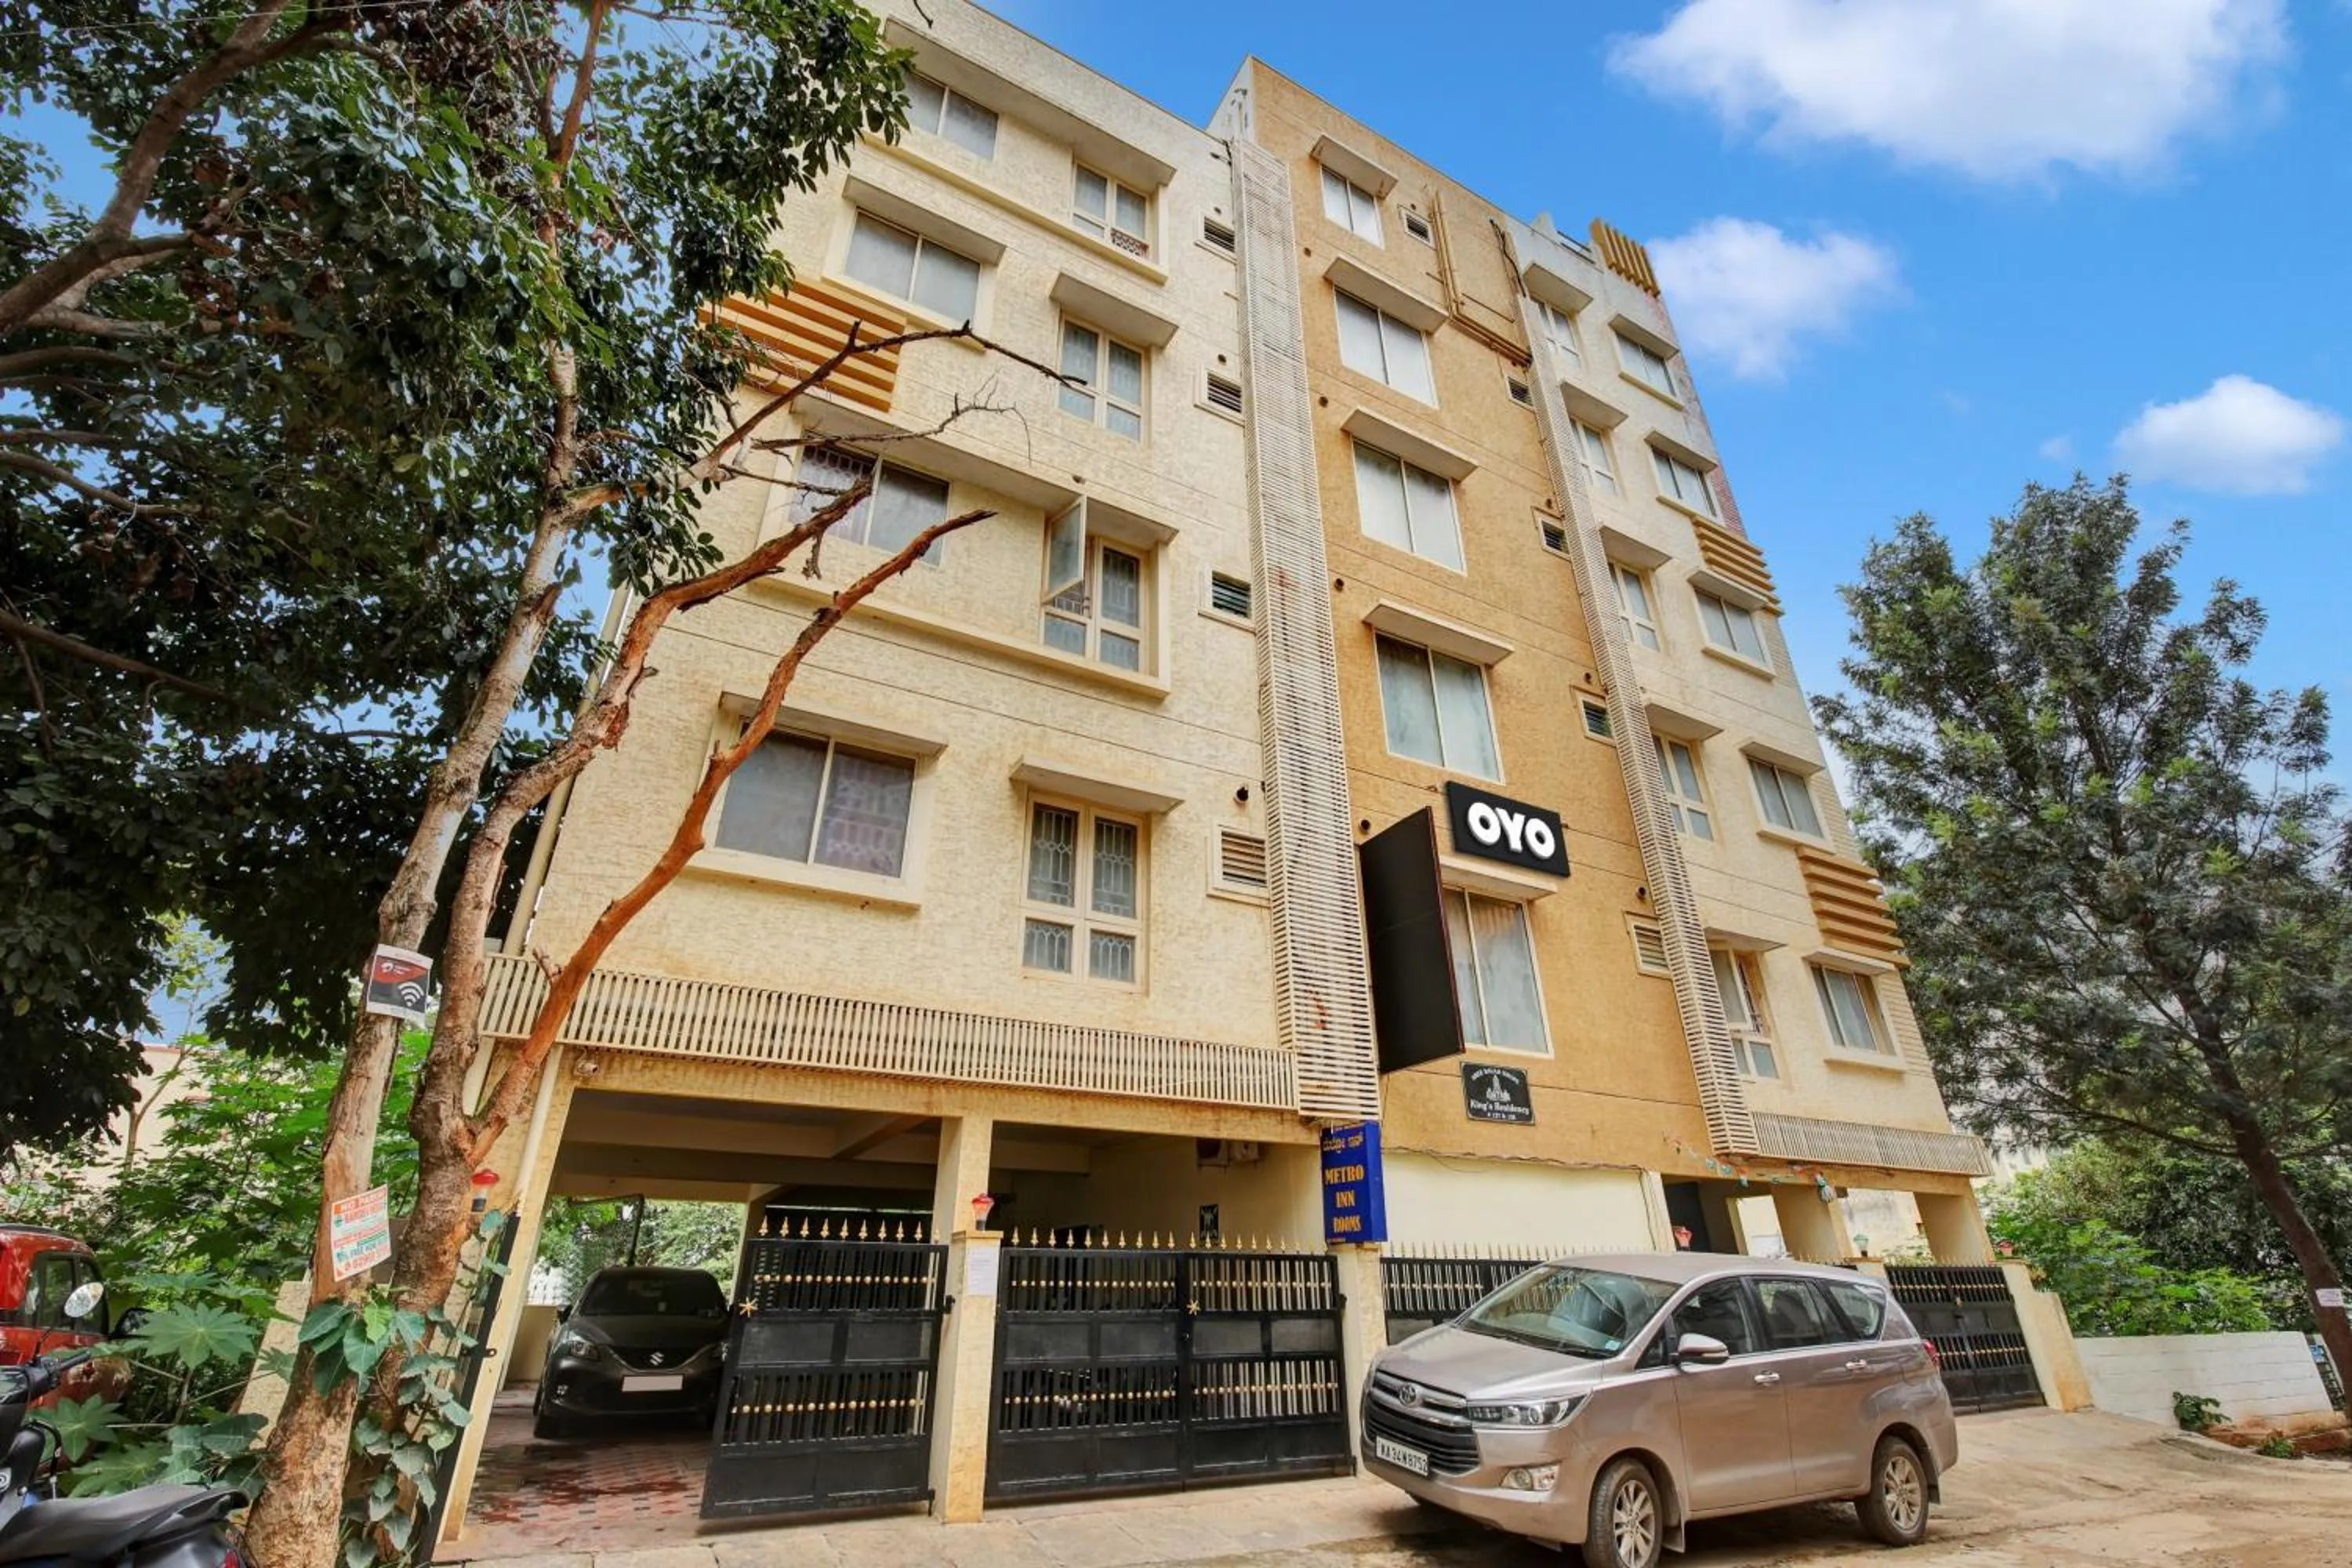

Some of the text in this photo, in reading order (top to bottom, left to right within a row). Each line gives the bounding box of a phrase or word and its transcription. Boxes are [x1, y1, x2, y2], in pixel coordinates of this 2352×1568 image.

[1467, 801, 1556, 860] OYO
[1325, 1164, 1364, 1185] METRO
[1336, 1189, 1355, 1207] INN
[1334, 1215, 1361, 1232] ROOMS
